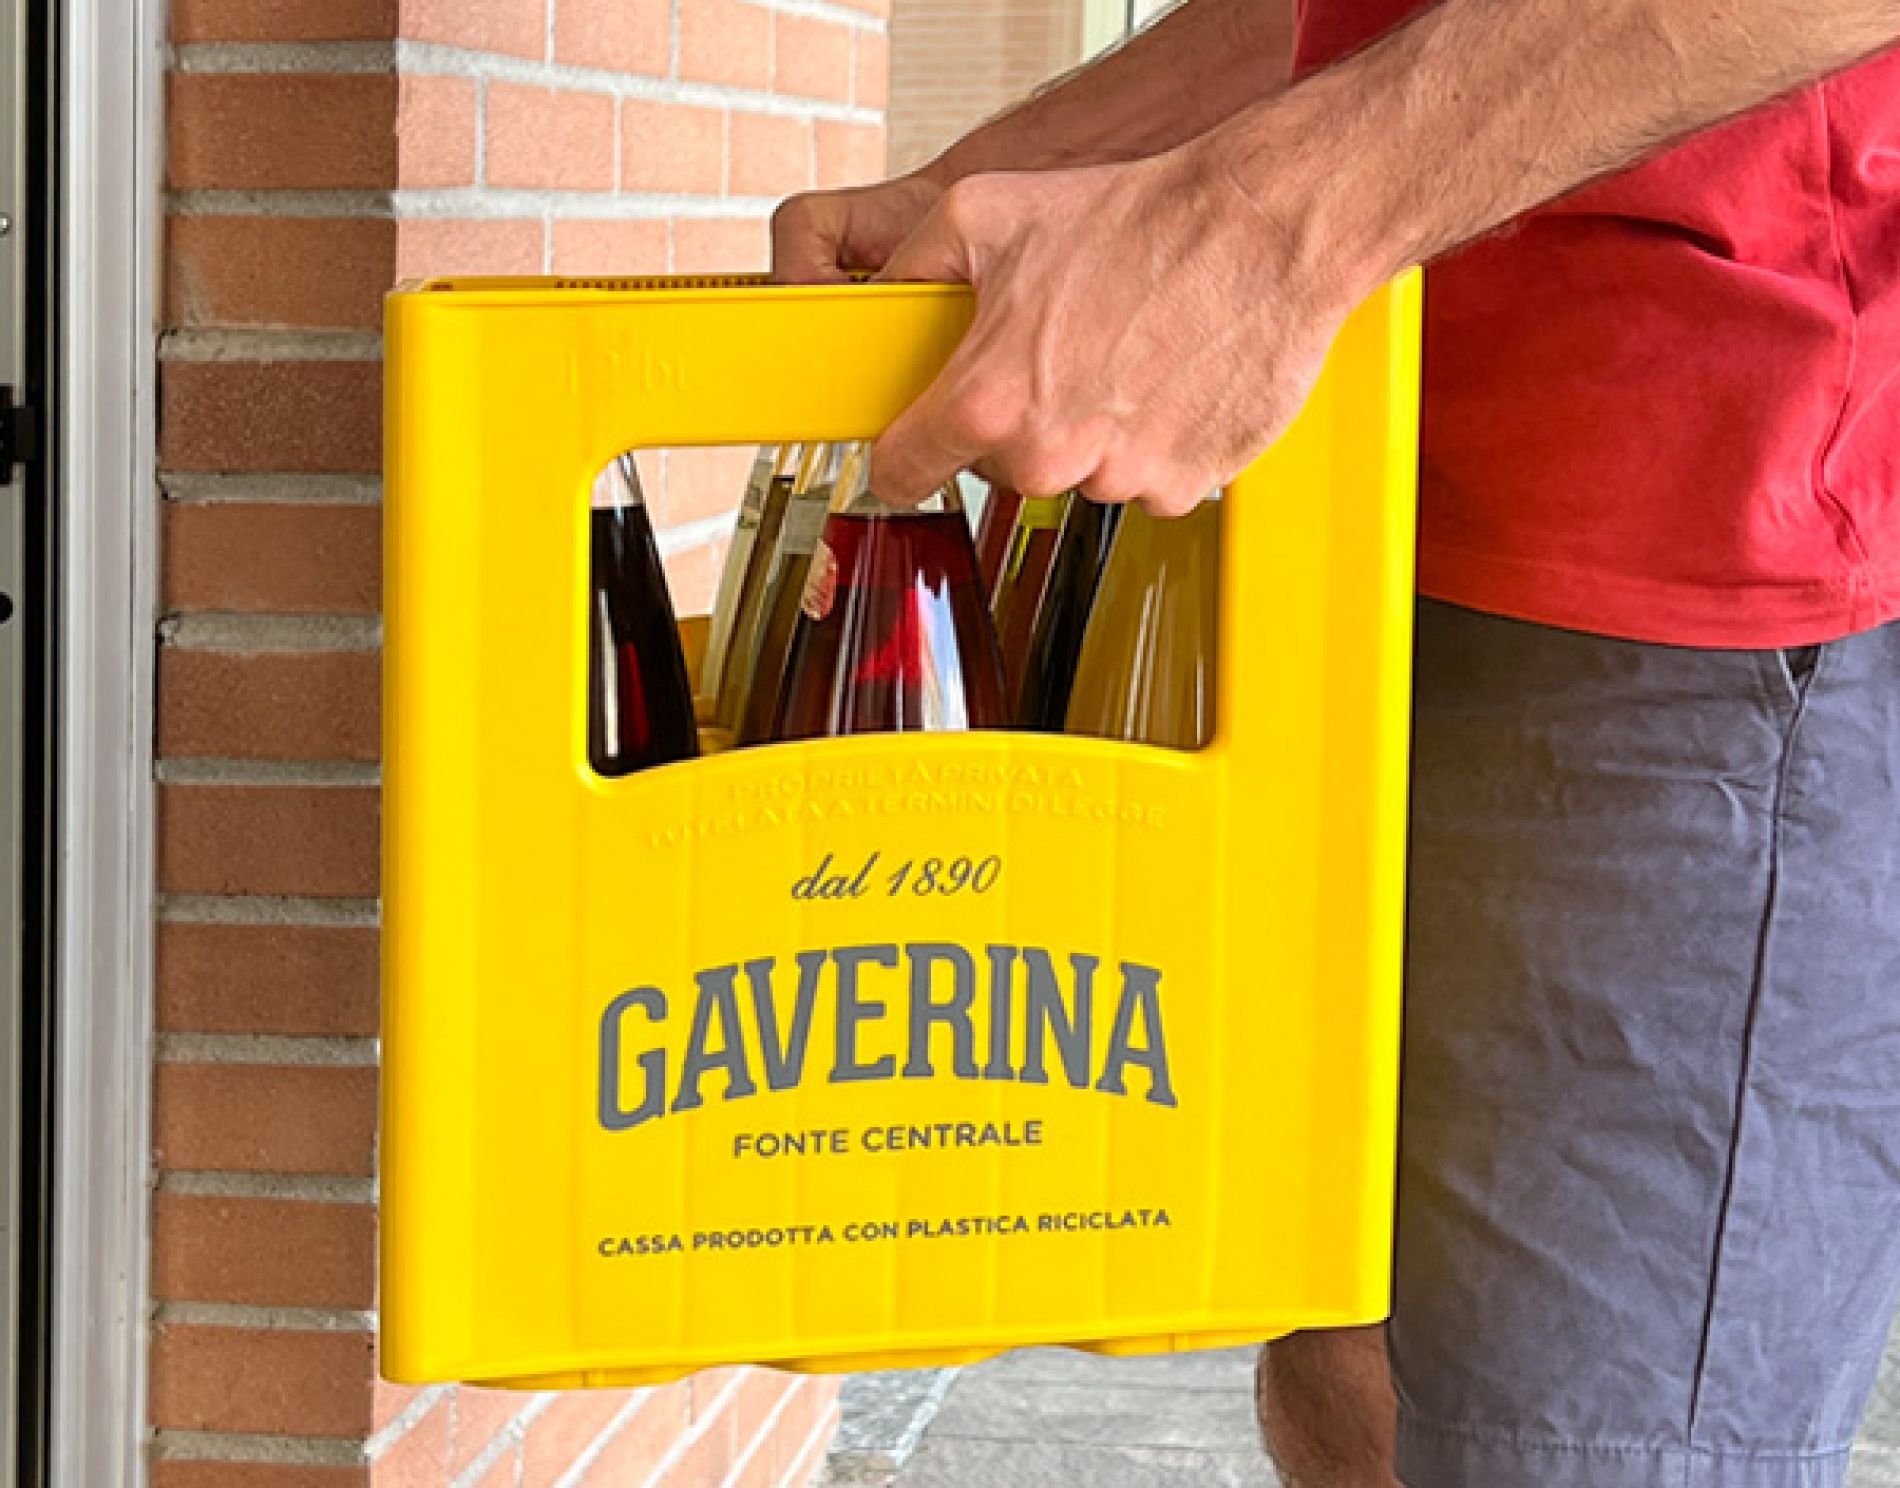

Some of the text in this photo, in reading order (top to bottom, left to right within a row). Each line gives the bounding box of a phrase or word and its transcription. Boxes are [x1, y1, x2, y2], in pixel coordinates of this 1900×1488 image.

[791, 851, 1001, 900] dal 1890
[597, 942, 1179, 1132] GAVERINA
[732, 1120, 1043, 1159] FONTE CENTRALE
[597, 1208, 1171, 1258] CASSA PRODOTTA CON PLASTICA RICICLATA
